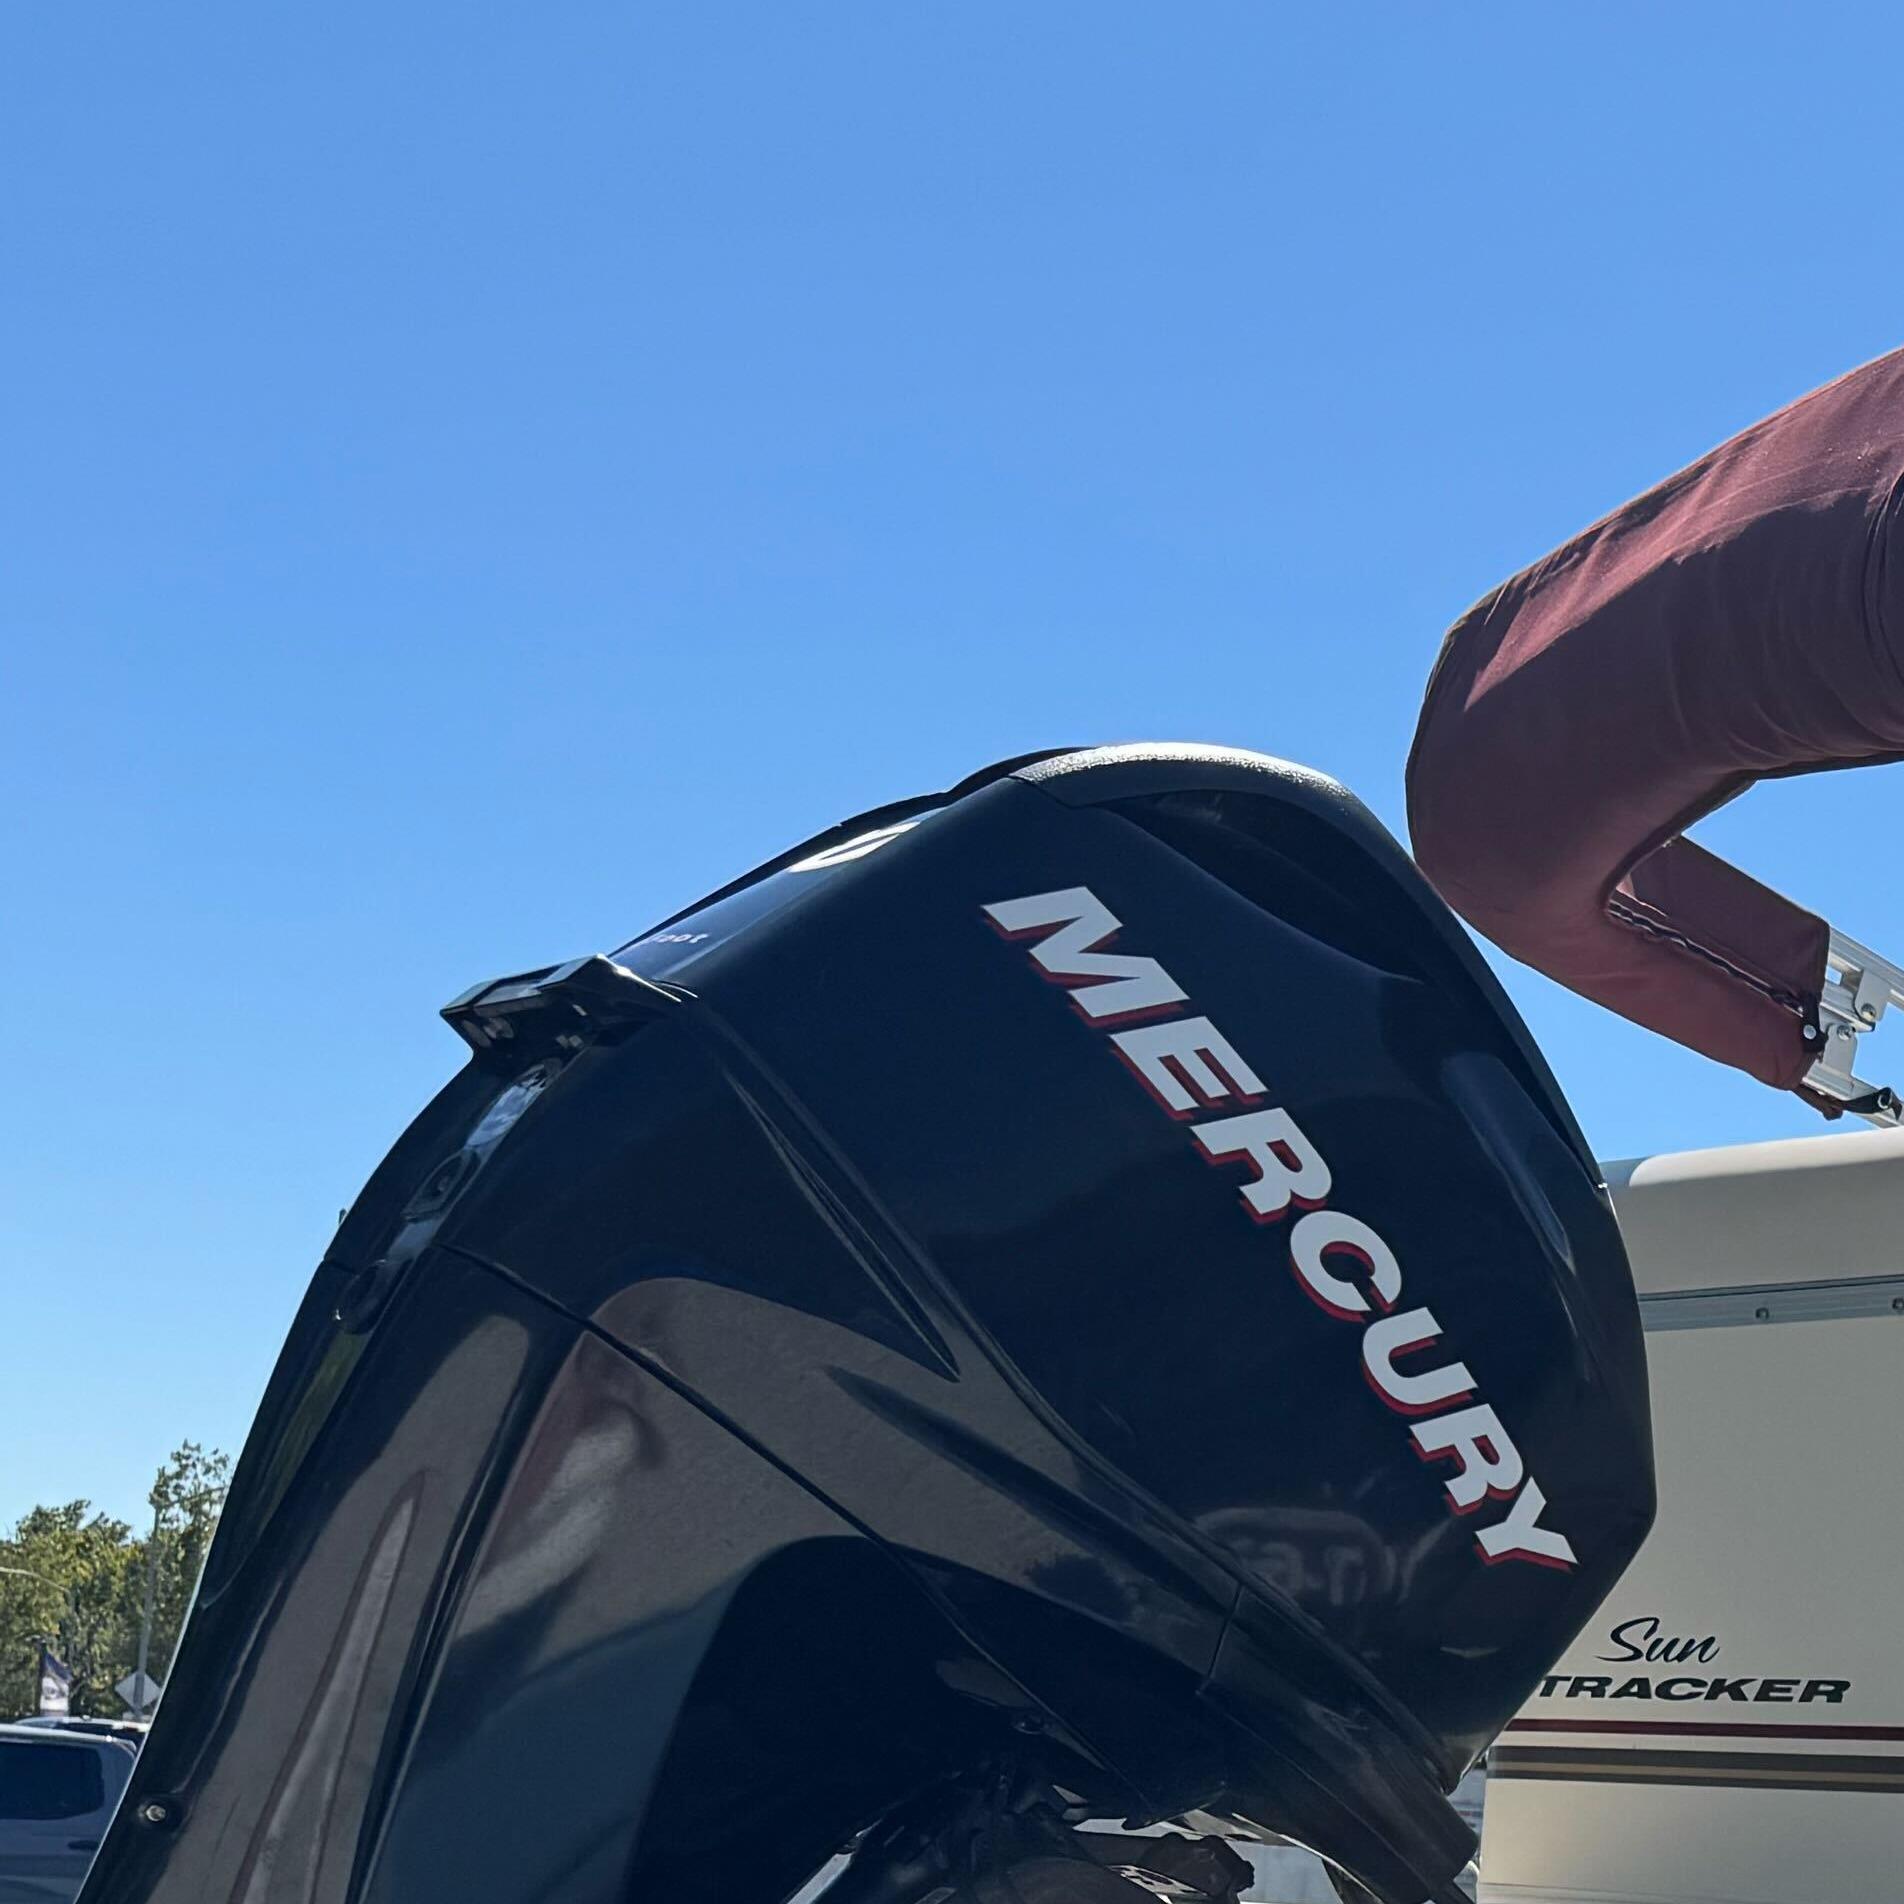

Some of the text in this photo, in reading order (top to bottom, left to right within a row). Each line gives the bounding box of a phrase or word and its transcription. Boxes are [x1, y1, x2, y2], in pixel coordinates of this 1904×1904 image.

[979, 885, 1580, 1572] MERCURY
[1595, 1616, 1720, 1664] Sun
[1539, 1675, 1852, 1704] TRACKER
